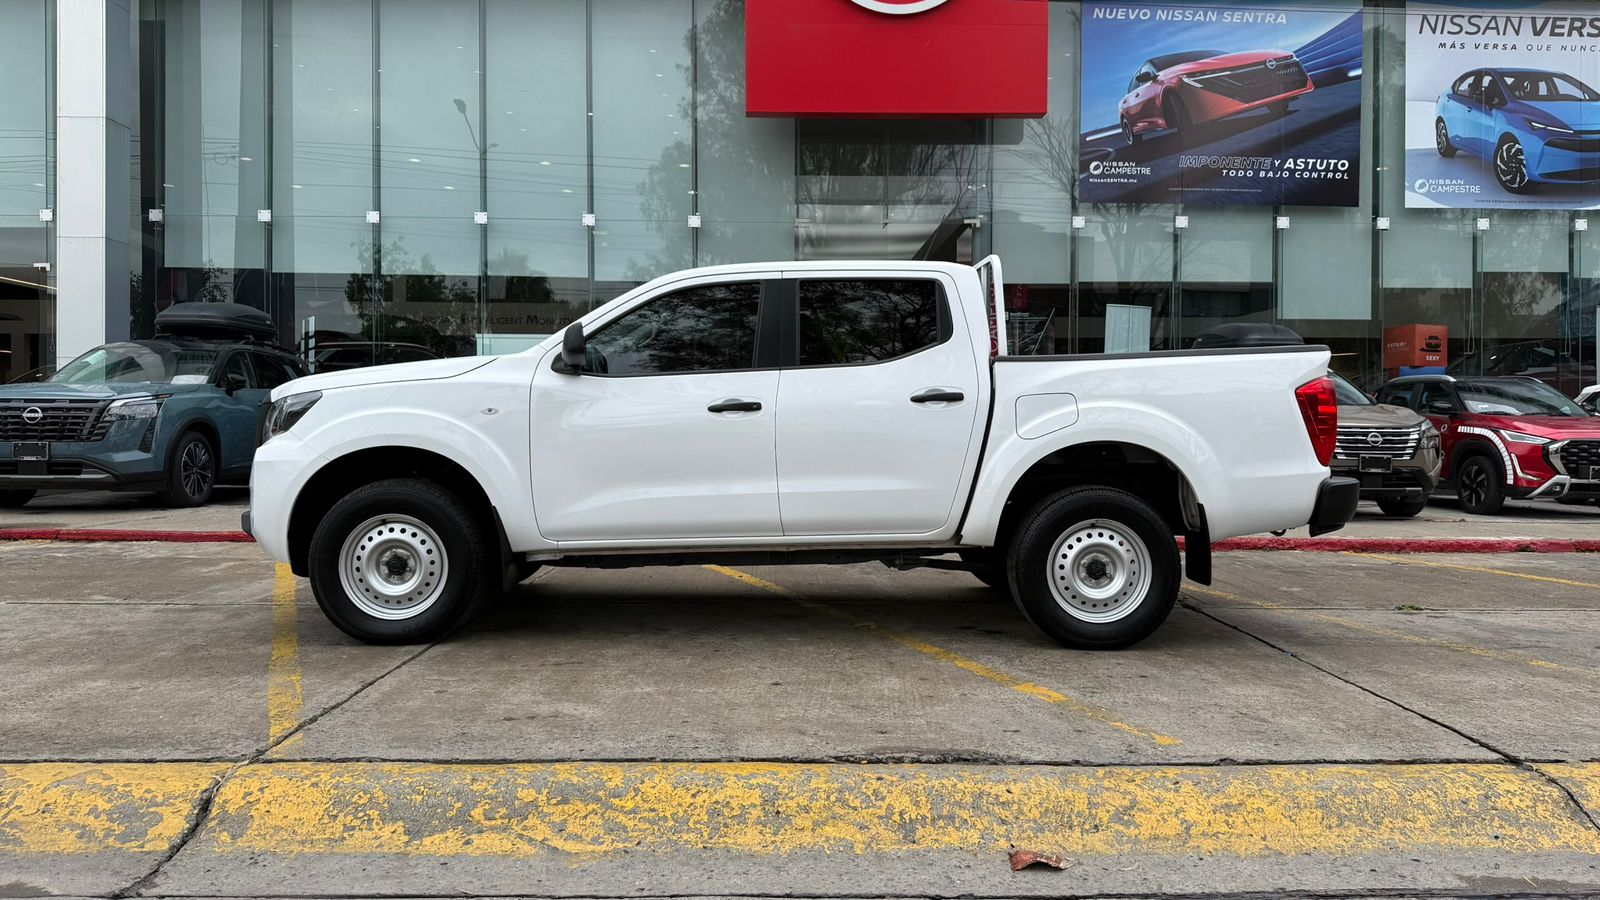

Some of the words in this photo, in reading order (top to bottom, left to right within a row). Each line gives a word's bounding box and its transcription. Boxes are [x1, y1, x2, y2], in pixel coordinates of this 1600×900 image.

[1093, 8, 1151, 20] NUEVO
[1155, 9, 1218, 22] NISSAN
[1222, 11, 1287, 25] SENTRA
[1418, 14, 1523, 36] NISSAN
[1438, 41, 1466, 50] MÁS
[1474, 42, 1517, 51] VERSA
[1526, 43, 1552, 52] QUE
[1179, 155, 1272, 169] IMPONENTE
[1274, 159, 1282, 167] Y
[1283, 158, 1349, 170] ASTUTO
[1103, 167, 1151, 175] CAMPESTRE
[1222, 169, 1254, 177] TODO
[1259, 170, 1290, 178] BAJO
[1295, 171, 1349, 180] CONTROL
[1430, 185, 1481, 193] CAMPESTRE
